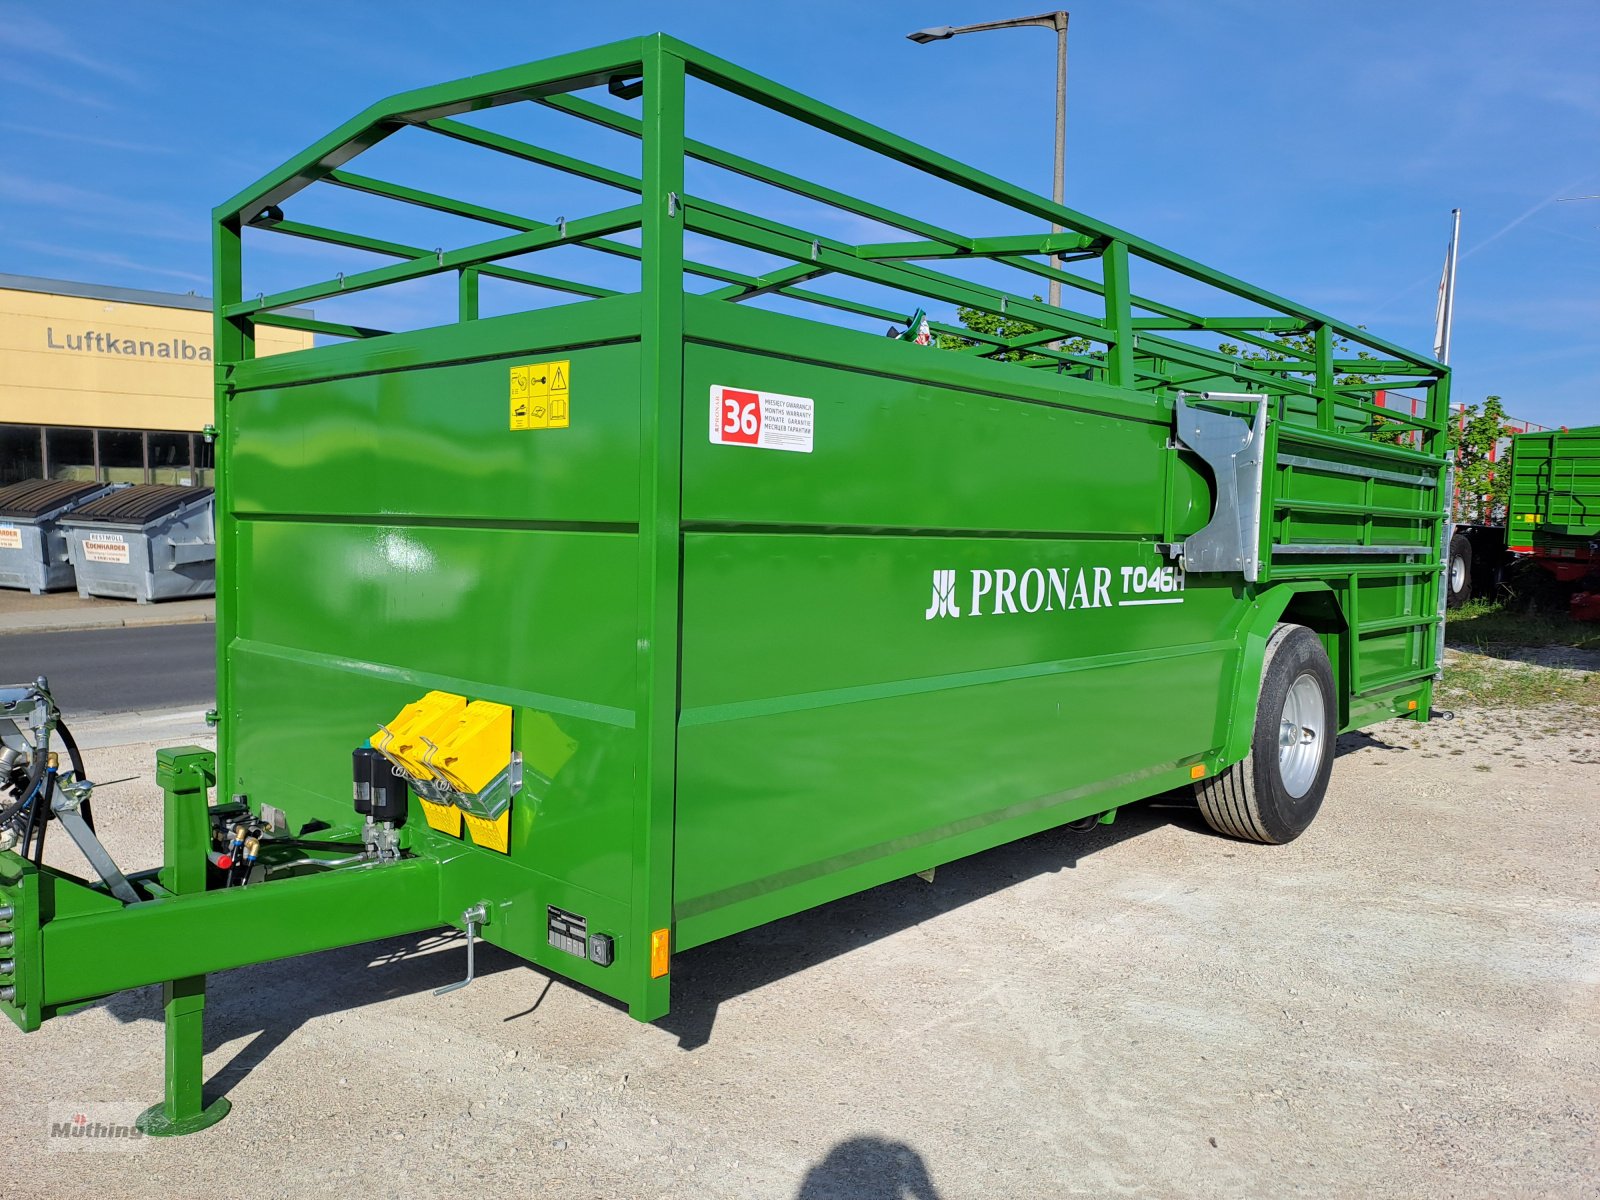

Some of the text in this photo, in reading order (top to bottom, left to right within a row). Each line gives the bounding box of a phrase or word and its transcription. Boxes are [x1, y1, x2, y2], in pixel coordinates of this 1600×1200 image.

[47, 327, 212, 361] Luftkanalba
[724, 399, 757, 435] 36
[764, 407, 811, 418] MONTHS WARRANTY
[764, 415, 811, 426] MONATE GARANTIE
[968, 567, 1113, 616] PRONAR
